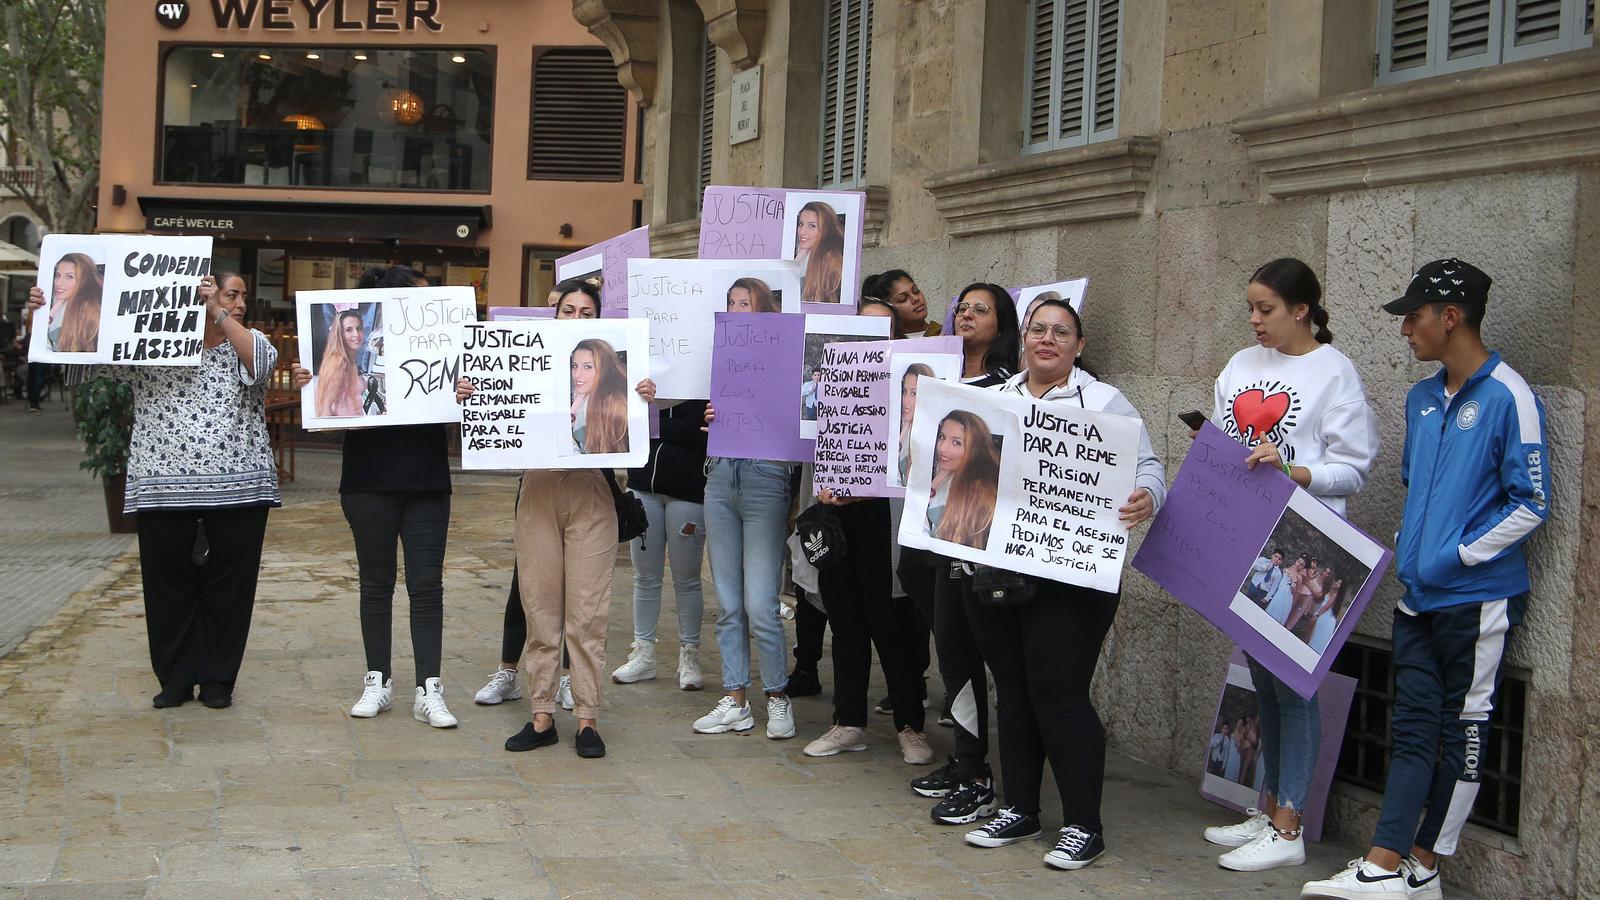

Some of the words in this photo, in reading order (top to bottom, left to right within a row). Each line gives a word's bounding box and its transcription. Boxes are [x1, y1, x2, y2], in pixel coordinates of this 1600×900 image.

[210, 0, 443, 32] WEYLER
[705, 193, 785, 226] JUSTICIA
[154, 216, 184, 227] CAFÉ
[186, 218, 234, 229] WEYLER
[702, 230, 765, 255] PARA
[134, 310, 199, 333] PARA
[390, 296, 477, 336] JUSTICIA
[641, 307, 678, 324] PARA
[409, 333, 452, 352] PARA
[648, 337, 692, 357] EME
[463, 353, 503, 372] PARA
[509, 354, 552, 372] REME
[863, 350, 884, 363] MAS
[399, 354, 460, 399] REM
[817, 401, 839, 418] PARA
[840, 405, 850, 416] EL
[462, 423, 500, 437] PARA
[507, 425, 525, 434] EL
[1024, 404, 1103, 443] JUSTICIA
[468, 438, 522, 451] ASESINO
[817, 435, 843, 450] PARA
[847, 439, 871, 450] ELLA
[875, 440, 887, 451] NO
[1023, 433, 1068, 457] PARA
[1076, 444, 1117, 466] REME
[815, 463, 829, 473] CON
[855, 454, 878, 463] ESTO
[814, 474, 826, 484] QUE
[1039, 459, 1100, 486] PRISION
[1022, 478, 1113, 510] PERMANENTE
[1029, 495, 1096, 520] REVISABLE
[1016, 508, 1048, 526] PARA
[1052, 518, 1071, 531] EL
[1075, 525, 1125, 545] ASESINO
[810, 545, 830, 563] adidas
[1005, 543, 1035, 558] HAGA
[1072, 541, 1094, 555] QUE
[1101, 547, 1118, 559] SE
